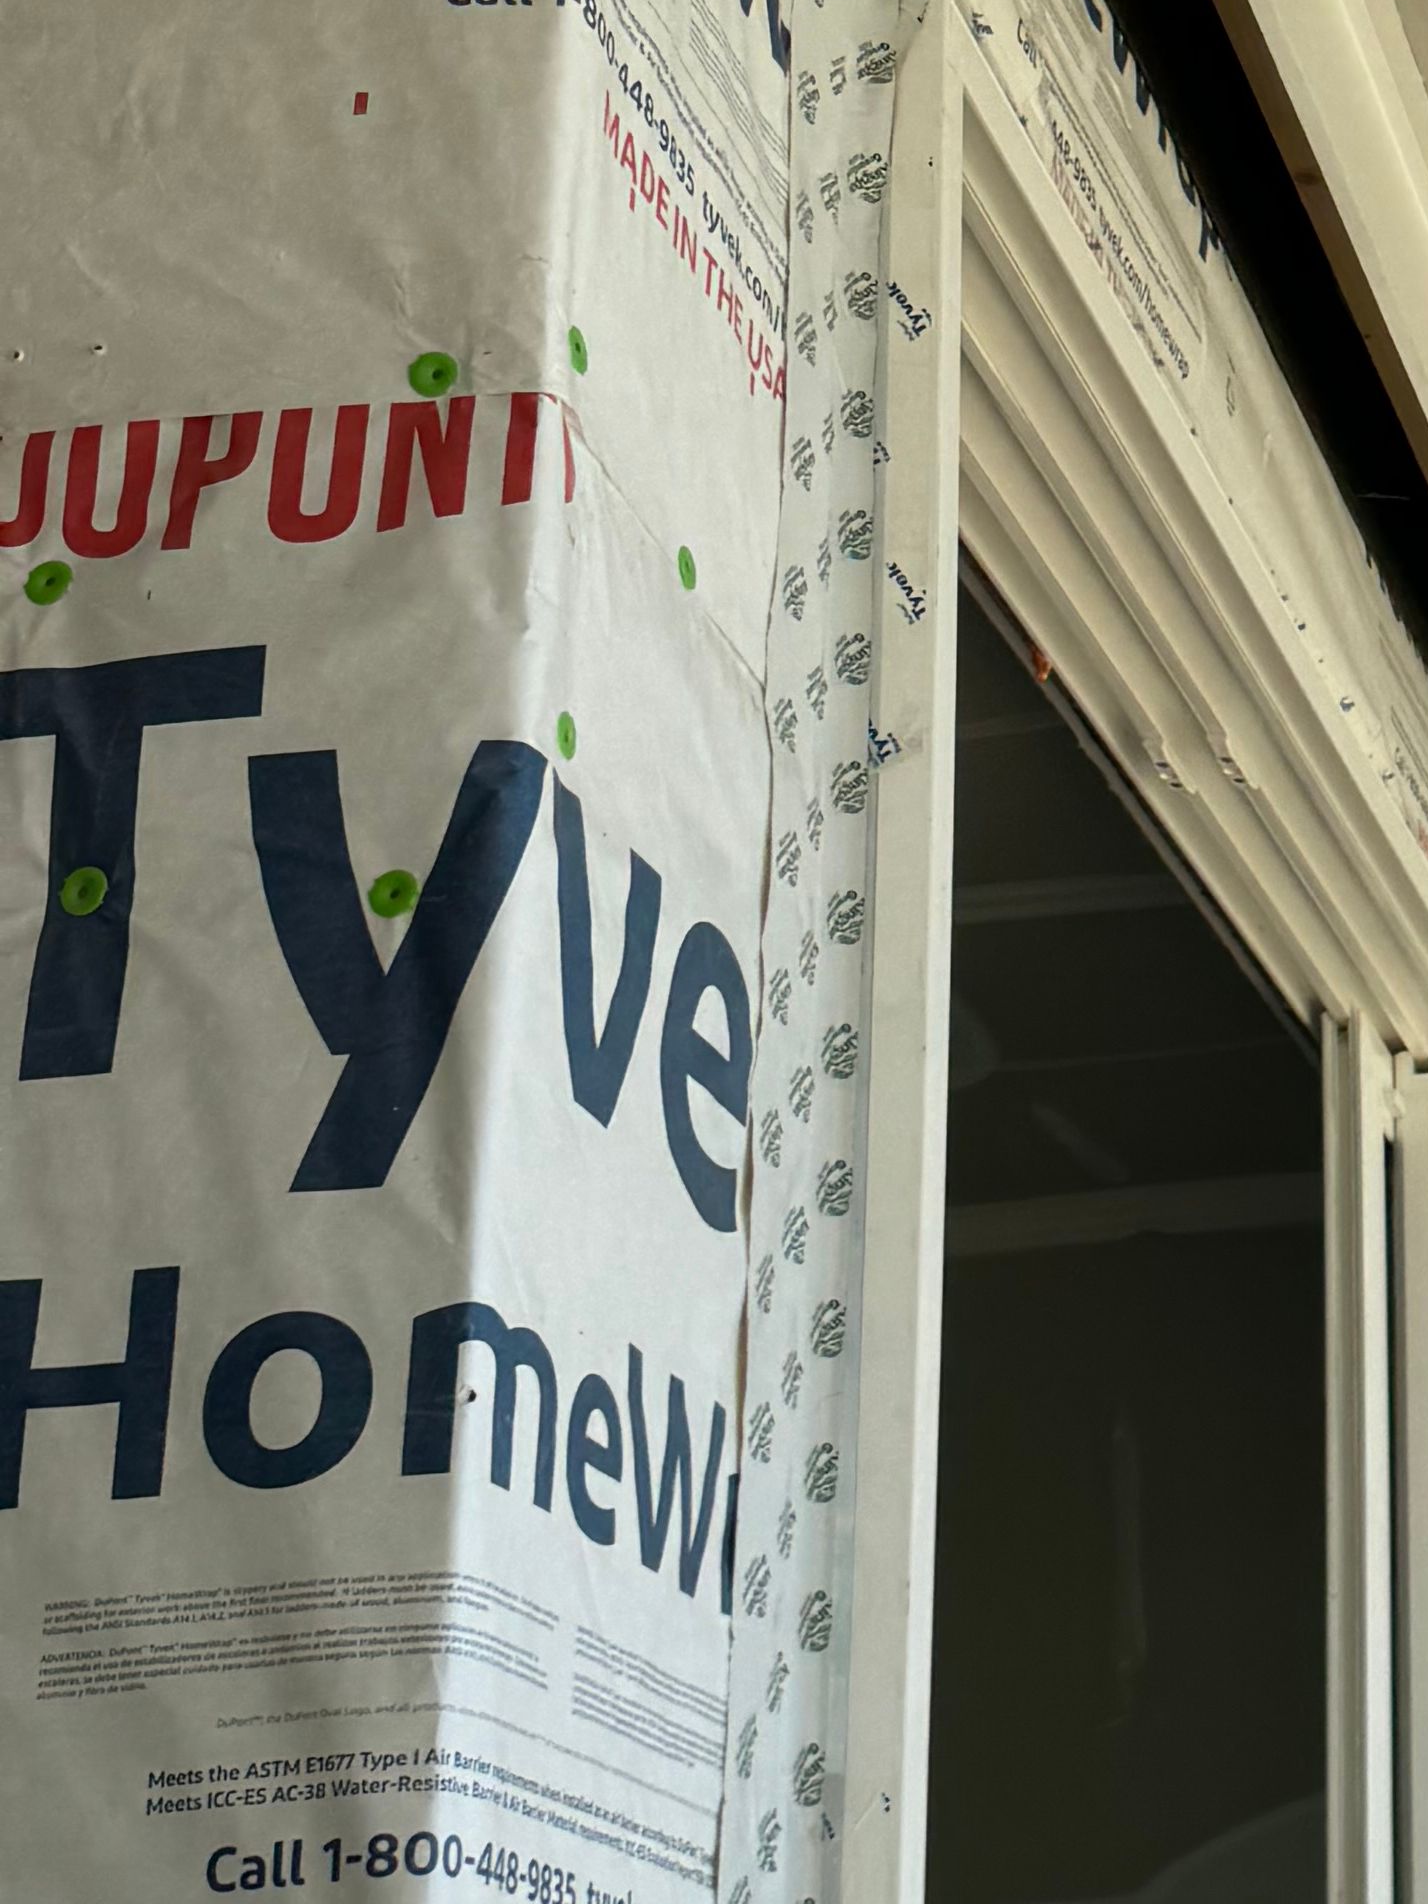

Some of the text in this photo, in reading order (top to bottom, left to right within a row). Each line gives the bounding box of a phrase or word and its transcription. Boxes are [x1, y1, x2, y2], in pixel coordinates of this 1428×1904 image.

[604, 90, 669, 231] MADE
[673, 205, 697, 274] IN
[703, 247, 744, 344] THE
[702, 191, 787, 341] tyvek.com/
[0, 645, 752, 1233] Tyve
[0, 1264, 740, 1616] HomeW
[146, 1797, 202, 1815] Meets
[207, 1790, 266, 1809] ICC-ES
[272, 1783, 326, 1803] AC-38
[332, 1773, 470, 1797] Water-Resistive
[148, 1770, 203, 1789] Meets
[209, 1764, 240, 1782] the
[244, 1759, 301, 1779] ASTM
[305, 1753, 355, 1774] E1677
[361, 1751, 402, 1771] Type
[425, 1747, 450, 1766] Air
[206, 1838, 305, 1892] Call
